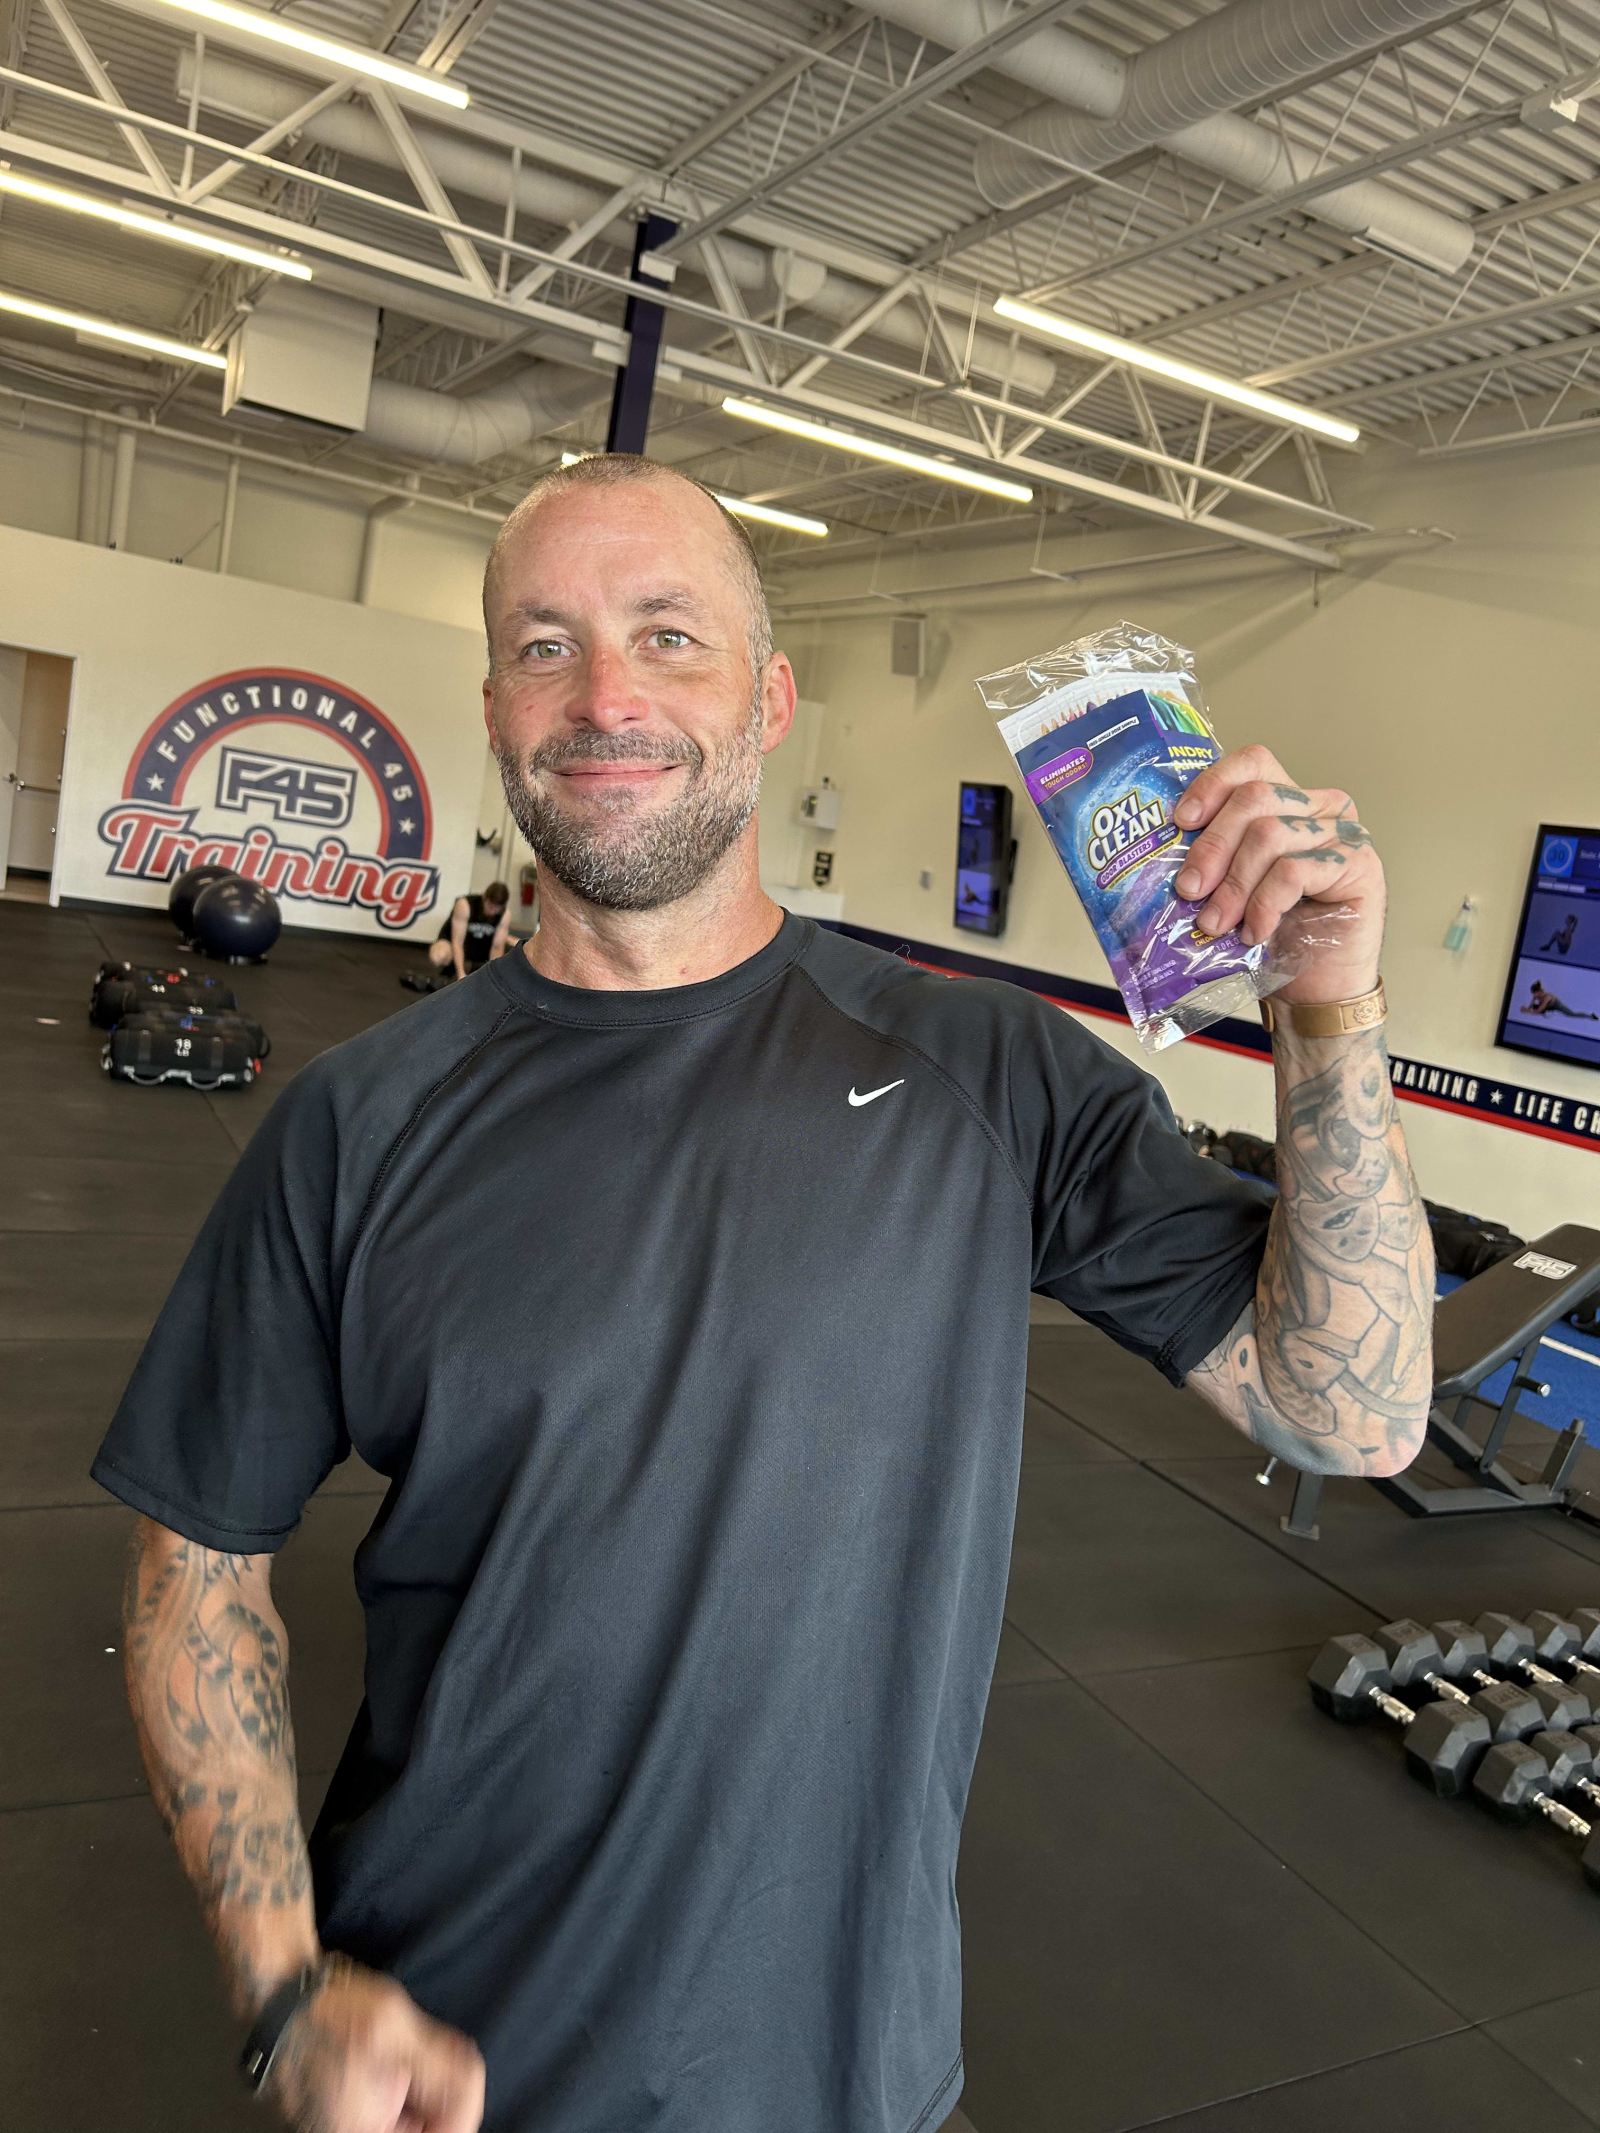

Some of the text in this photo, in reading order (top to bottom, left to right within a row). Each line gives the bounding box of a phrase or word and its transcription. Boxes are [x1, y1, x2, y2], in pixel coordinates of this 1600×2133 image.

[156, 685, 413, 802] FUNCTIONAL 45
[1040, 755, 1086, 785] ELIMINATES
[216, 747, 358, 828] F45
[1045, 775, 1065, 791] TOUGH
[1093, 793, 1139, 838] OXI
[100, 804, 439, 928] Training
[1089, 802, 1164, 871] CLEAN
[1101, 864, 1118, 884] ODOR
[1117, 839, 1153, 868] BLASTERS
[1388, 1059, 1478, 1103] RAINING
[1514, 1092, 1563, 1124] LIFE
